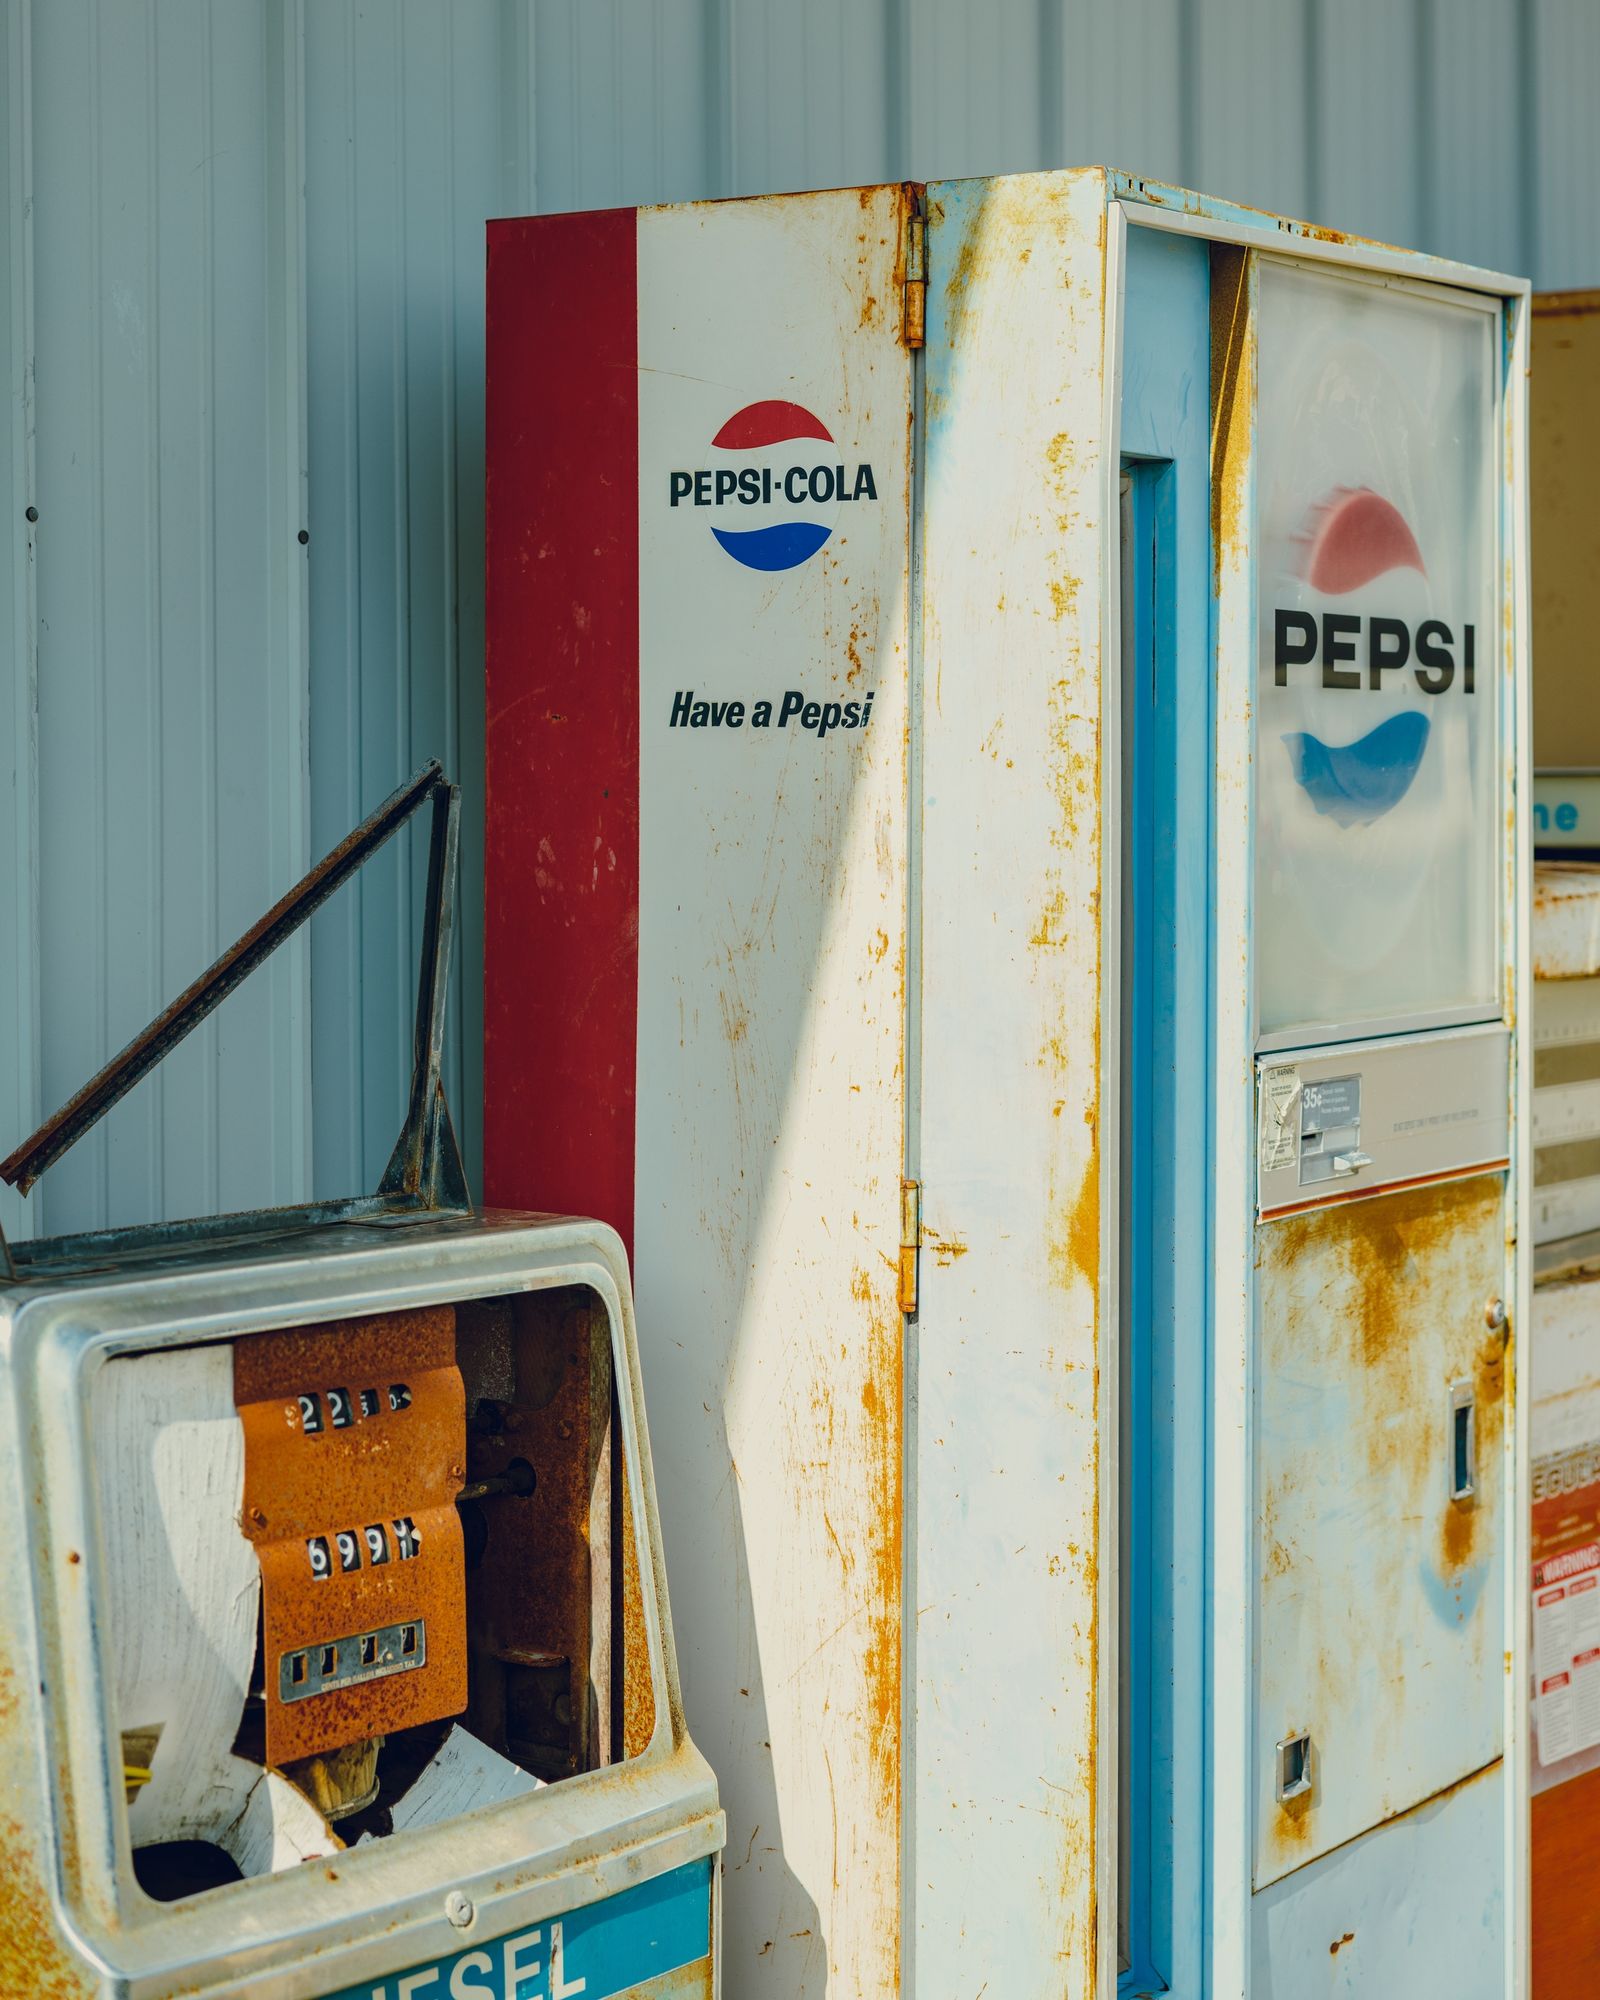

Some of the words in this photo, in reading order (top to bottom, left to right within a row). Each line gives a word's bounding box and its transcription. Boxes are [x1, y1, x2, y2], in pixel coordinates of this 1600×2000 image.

[1274, 608, 1475, 695] PEPSI
[669, 691, 745, 728] Have
[751, 701, 772, 728] a
[777, 691, 875, 738] Pepsi
[372, 1921, 586, 2000] SEL
